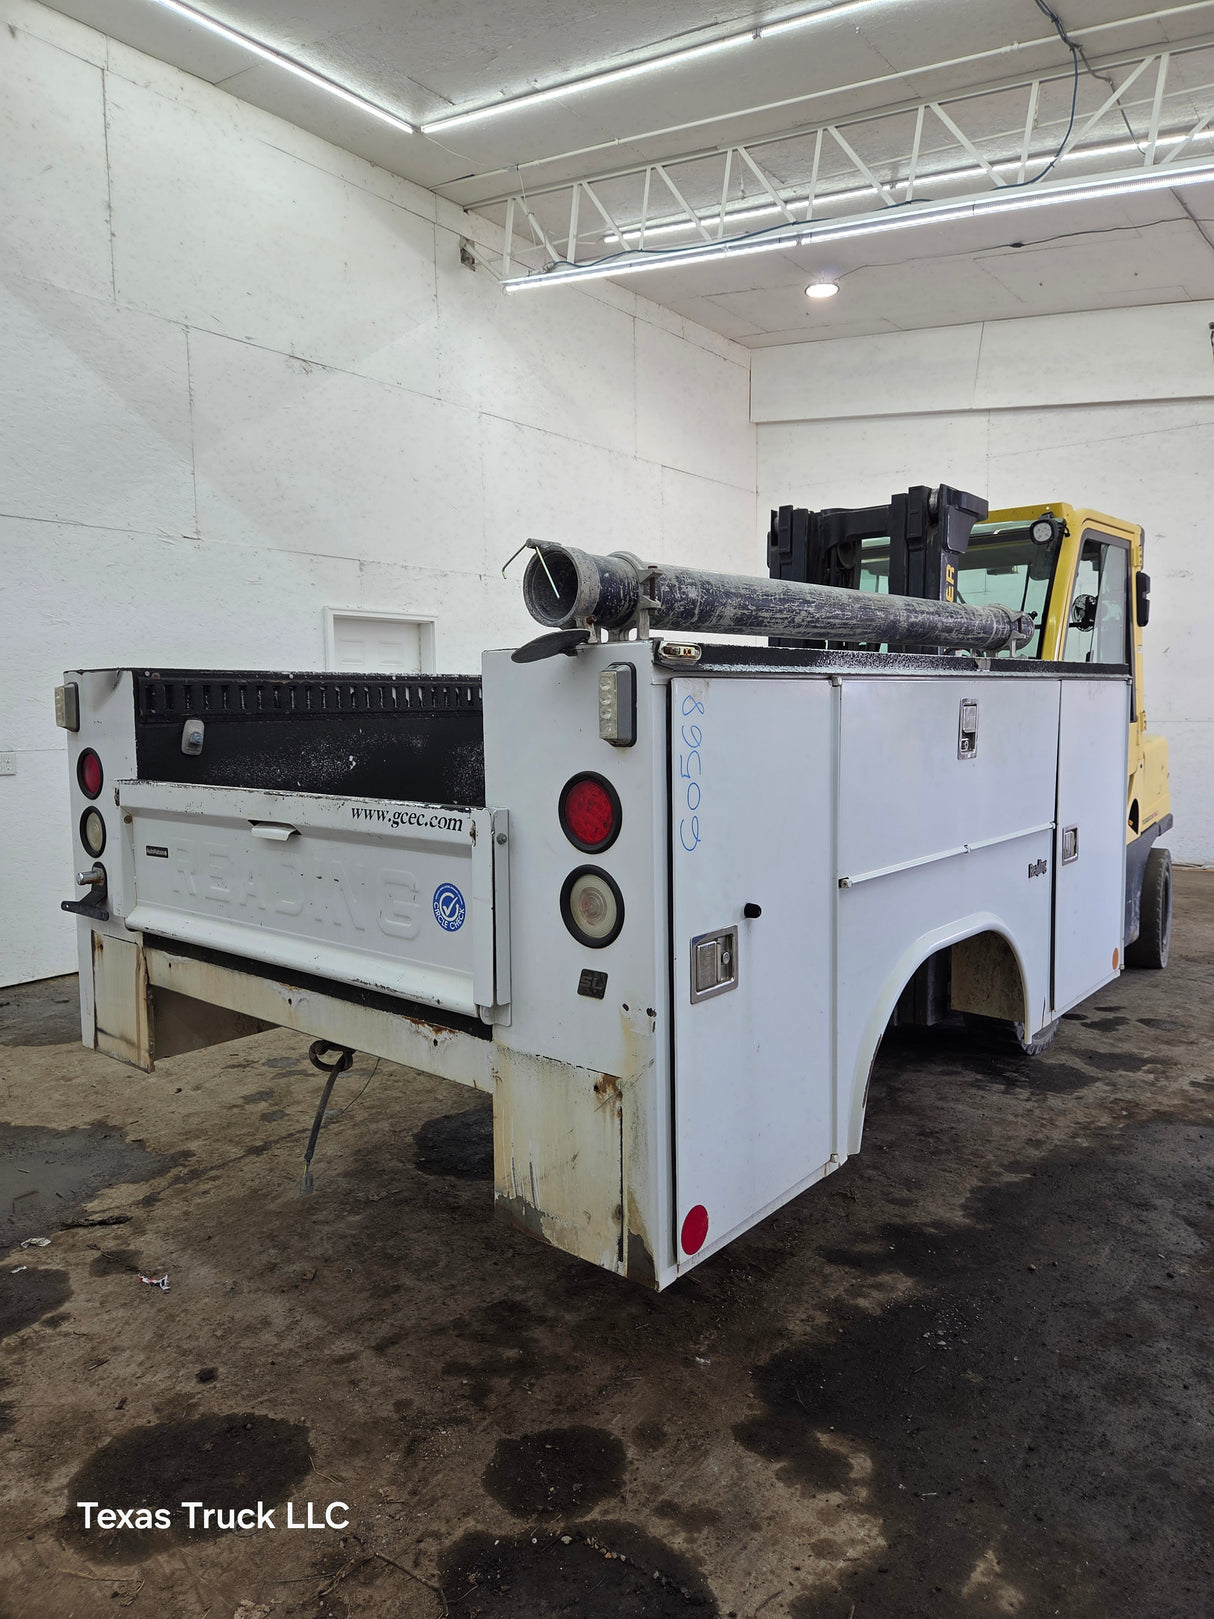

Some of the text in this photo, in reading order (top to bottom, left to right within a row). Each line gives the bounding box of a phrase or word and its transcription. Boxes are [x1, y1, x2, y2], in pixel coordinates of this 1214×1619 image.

[679, 694, 705, 852] 60568
[351, 807, 463, 831] www.gcec.com
[433, 901, 465, 930] CIRCLE CHECK
